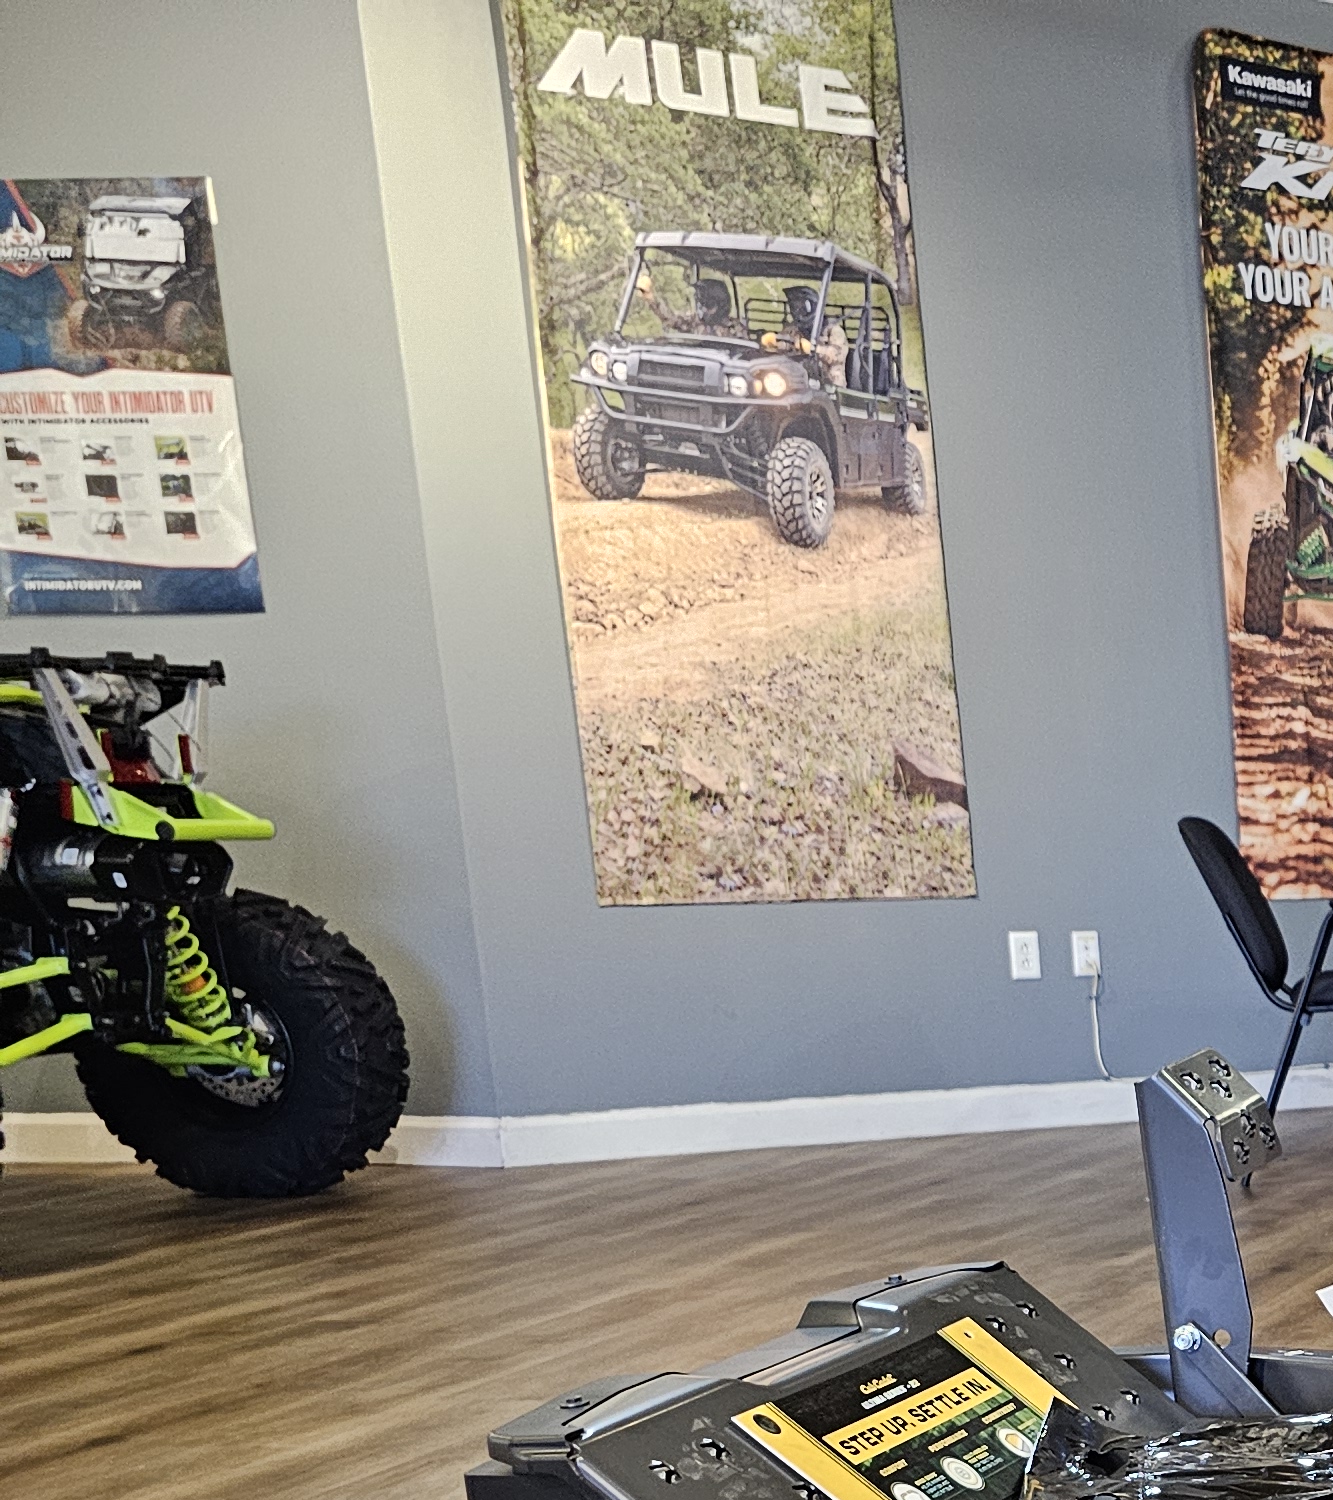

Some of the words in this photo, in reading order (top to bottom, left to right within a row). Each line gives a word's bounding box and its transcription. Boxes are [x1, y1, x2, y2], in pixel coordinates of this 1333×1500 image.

[536, 28, 880, 140] MULE
[1227, 64, 1312, 98] Kawasaki
[0, 246, 73, 259] MIDATOR
[1238, 262, 1312, 307] YOUR
[0, 391, 68, 415] CUSTOMIZE
[71, 391, 106, 414] YOUR
[108, 391, 187, 414] INTIMIDATOR
[189, 390, 214, 413] UTV
[838, 1427, 885, 1456] STEP
[880, 1416, 917, 1435] UP.
[907, 1387, 971, 1423] SETTLE
[962, 1378, 992, 1397] IN.
